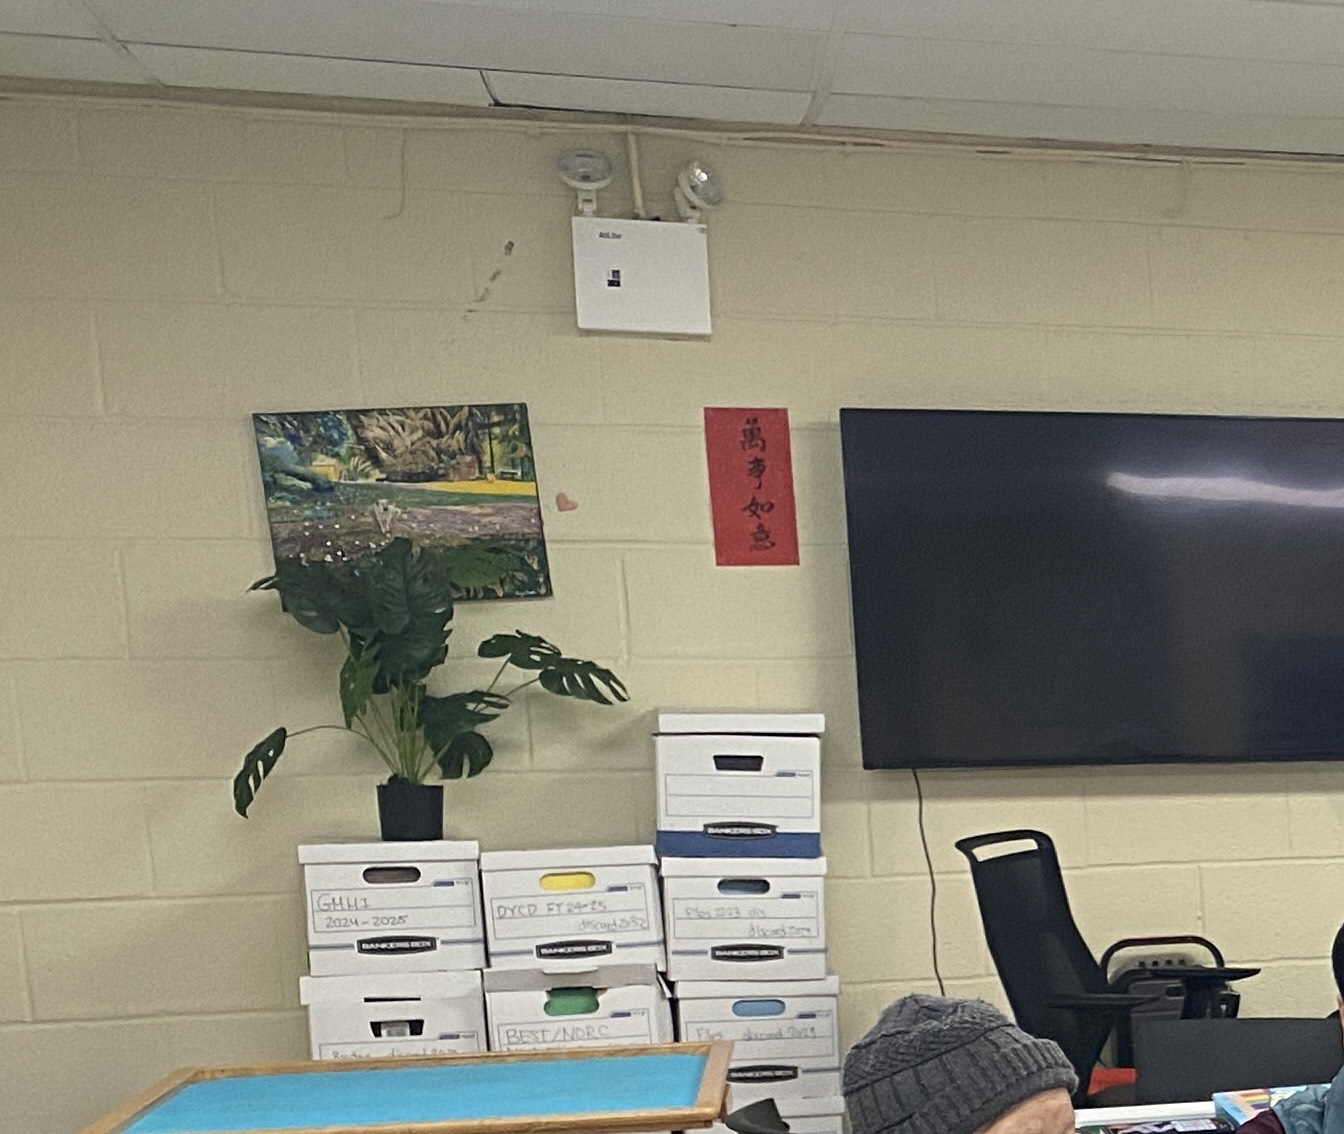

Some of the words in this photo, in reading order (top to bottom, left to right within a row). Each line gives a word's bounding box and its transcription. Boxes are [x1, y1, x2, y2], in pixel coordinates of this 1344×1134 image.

[739, 416, 777, 551] 萬事如意
[361, 942, 410, 950] BANKERS
[540, 946, 587, 955] BANKERS
[587, 944, 607, 952] BOX
